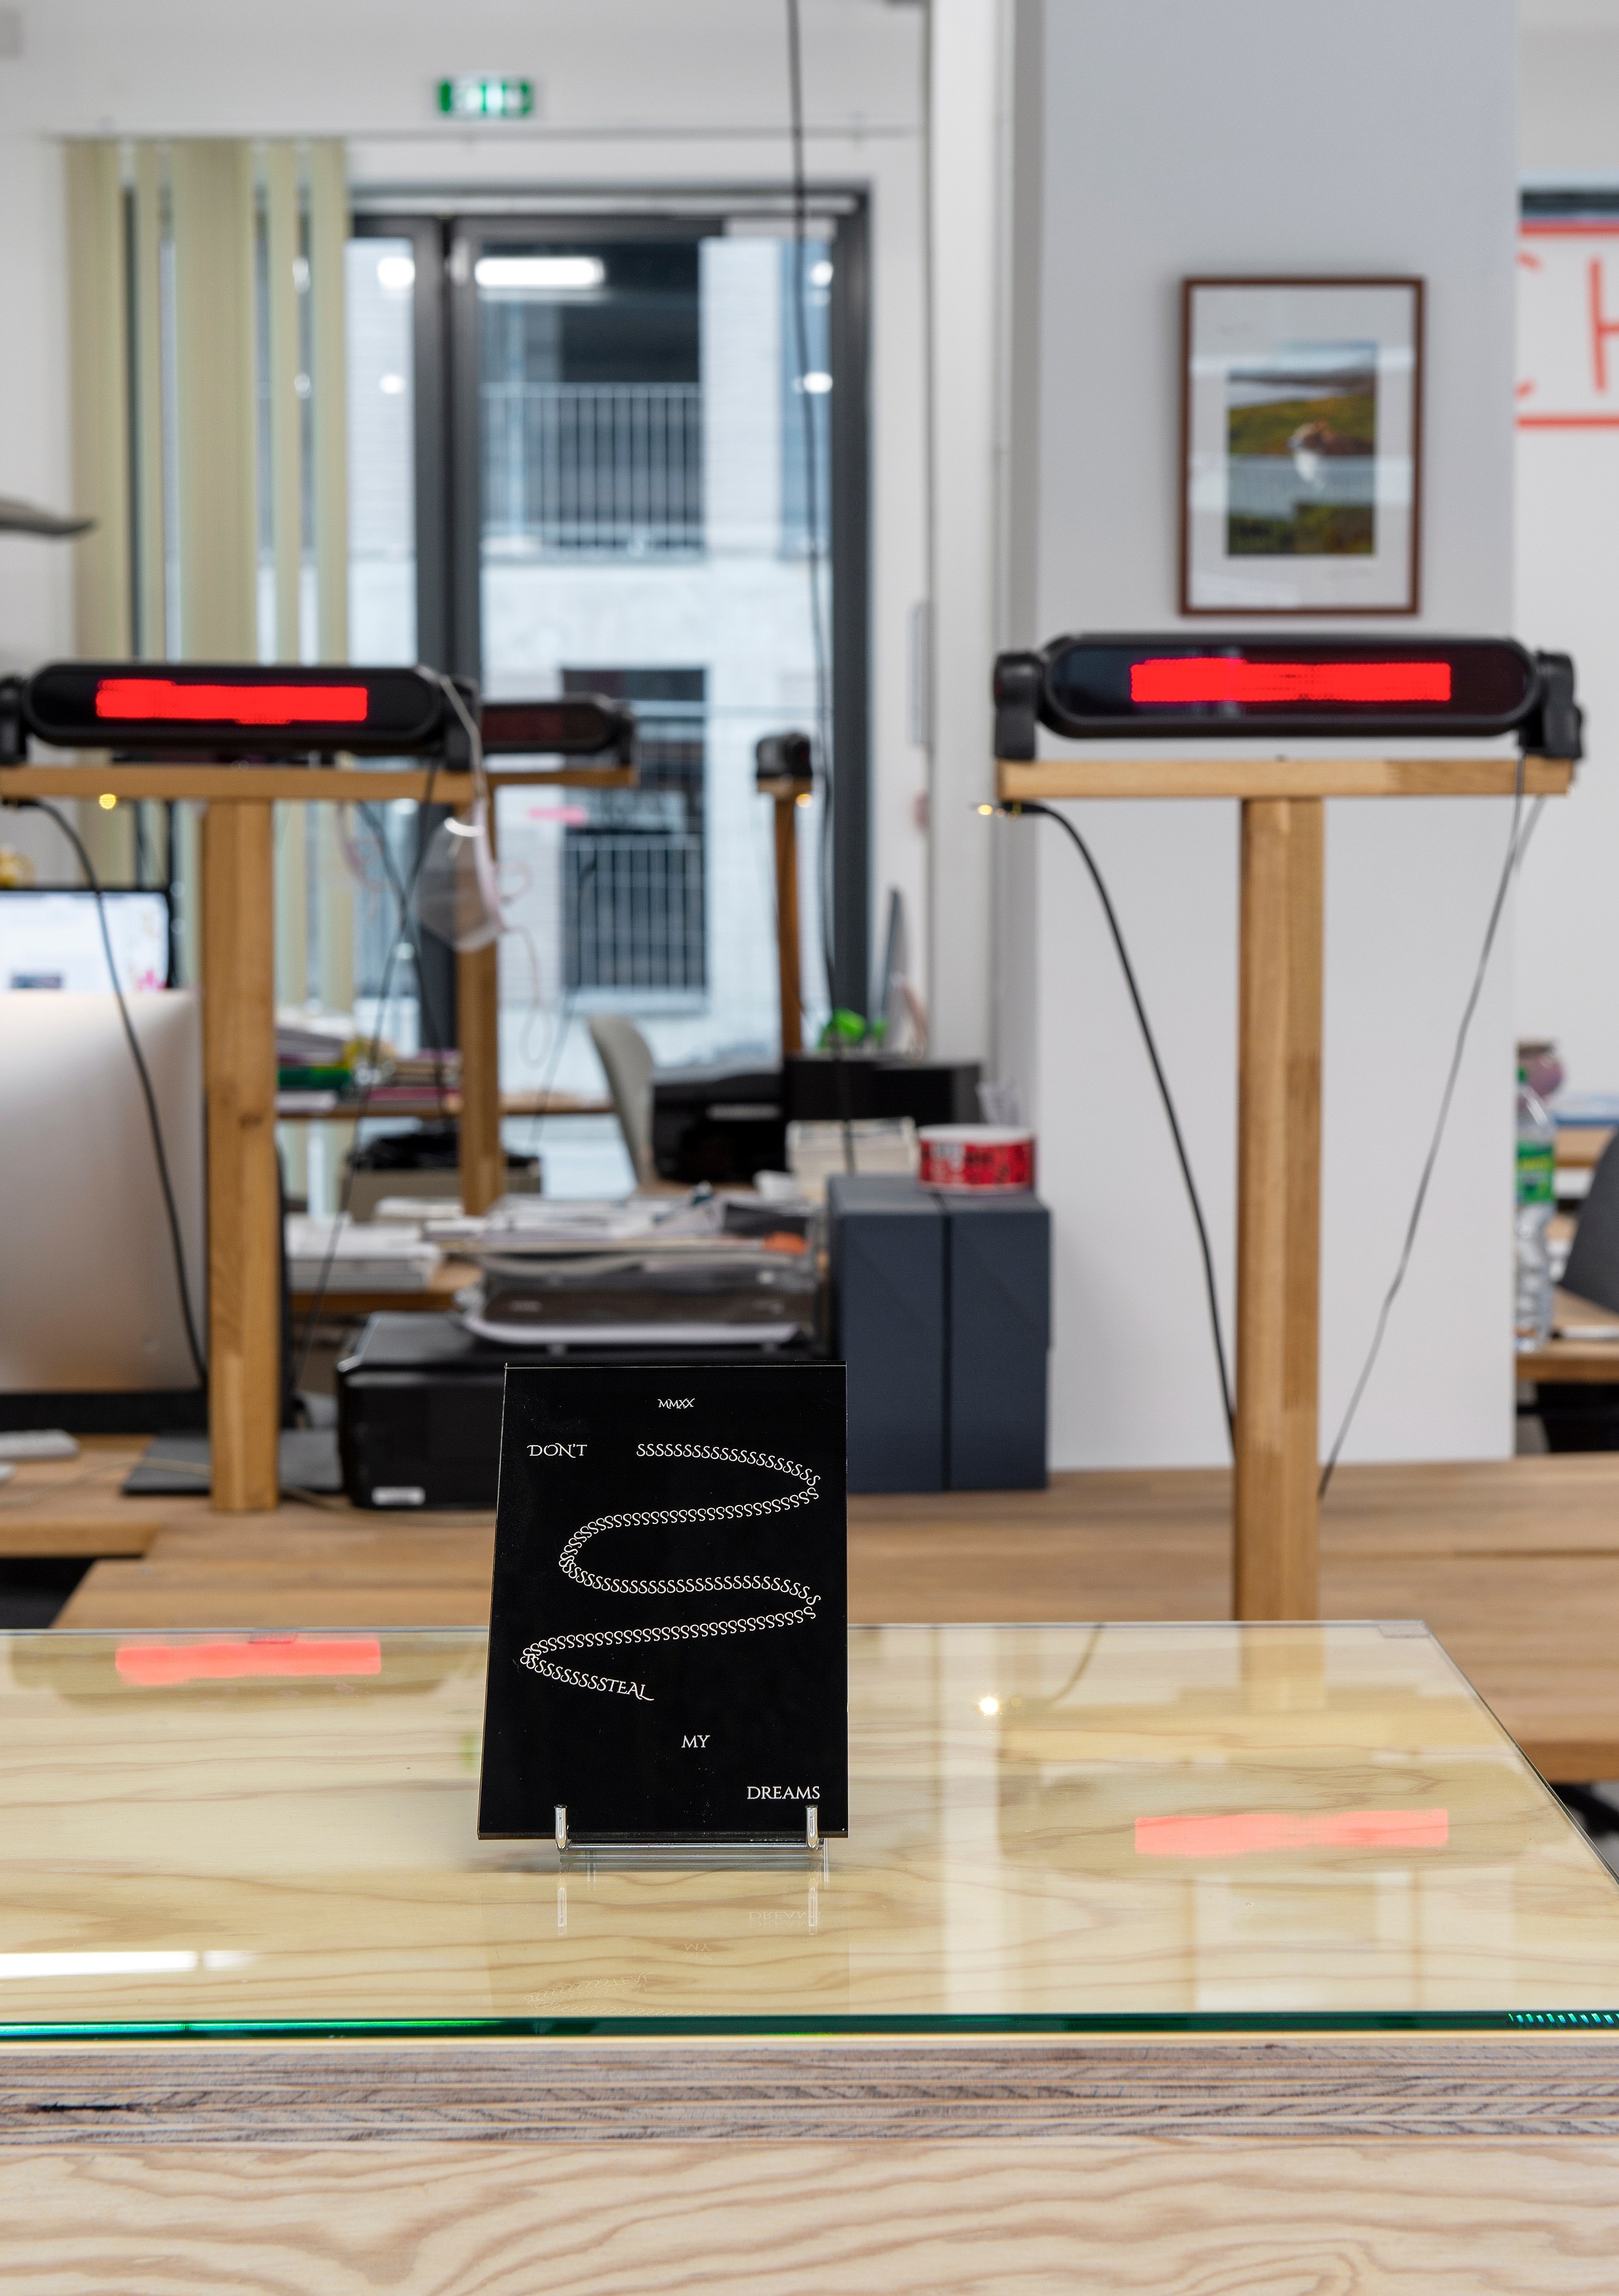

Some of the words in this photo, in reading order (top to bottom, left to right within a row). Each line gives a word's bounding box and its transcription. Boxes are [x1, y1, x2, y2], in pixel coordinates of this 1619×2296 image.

[657, 1398, 695, 1409] MMXX
[527, 1443, 588, 1458] DON'T
[681, 1734, 710, 1748] MY
[747, 1786, 821, 1799] DREAMS
